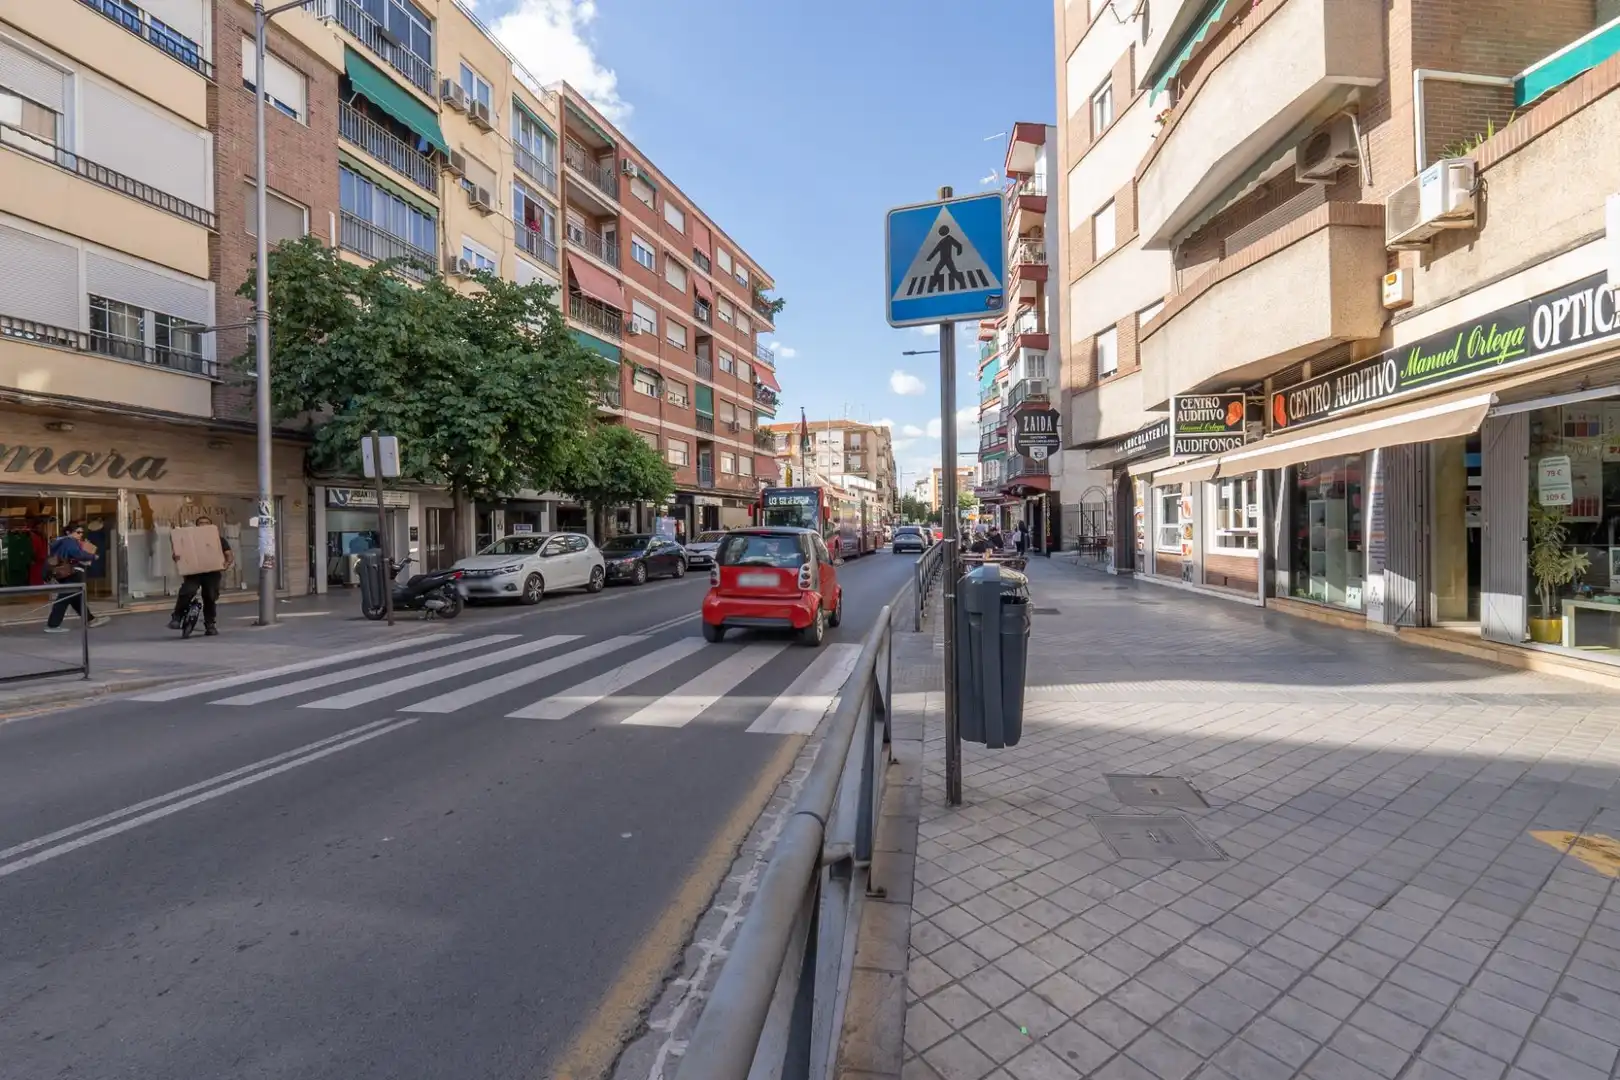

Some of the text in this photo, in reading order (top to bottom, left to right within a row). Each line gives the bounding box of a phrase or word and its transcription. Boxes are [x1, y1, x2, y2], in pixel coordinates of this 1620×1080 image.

[1289, 283, 1620, 420] CENTRO AUDITIVO Manuel Ortega OPTIC
[1180, 397, 1220, 410] CENTRO
[1177, 408, 1224, 422] AUDITIVO
[1024, 415, 1052, 432] ZAIDA
[1176, 438, 1242, 453] AUDIFONOS
